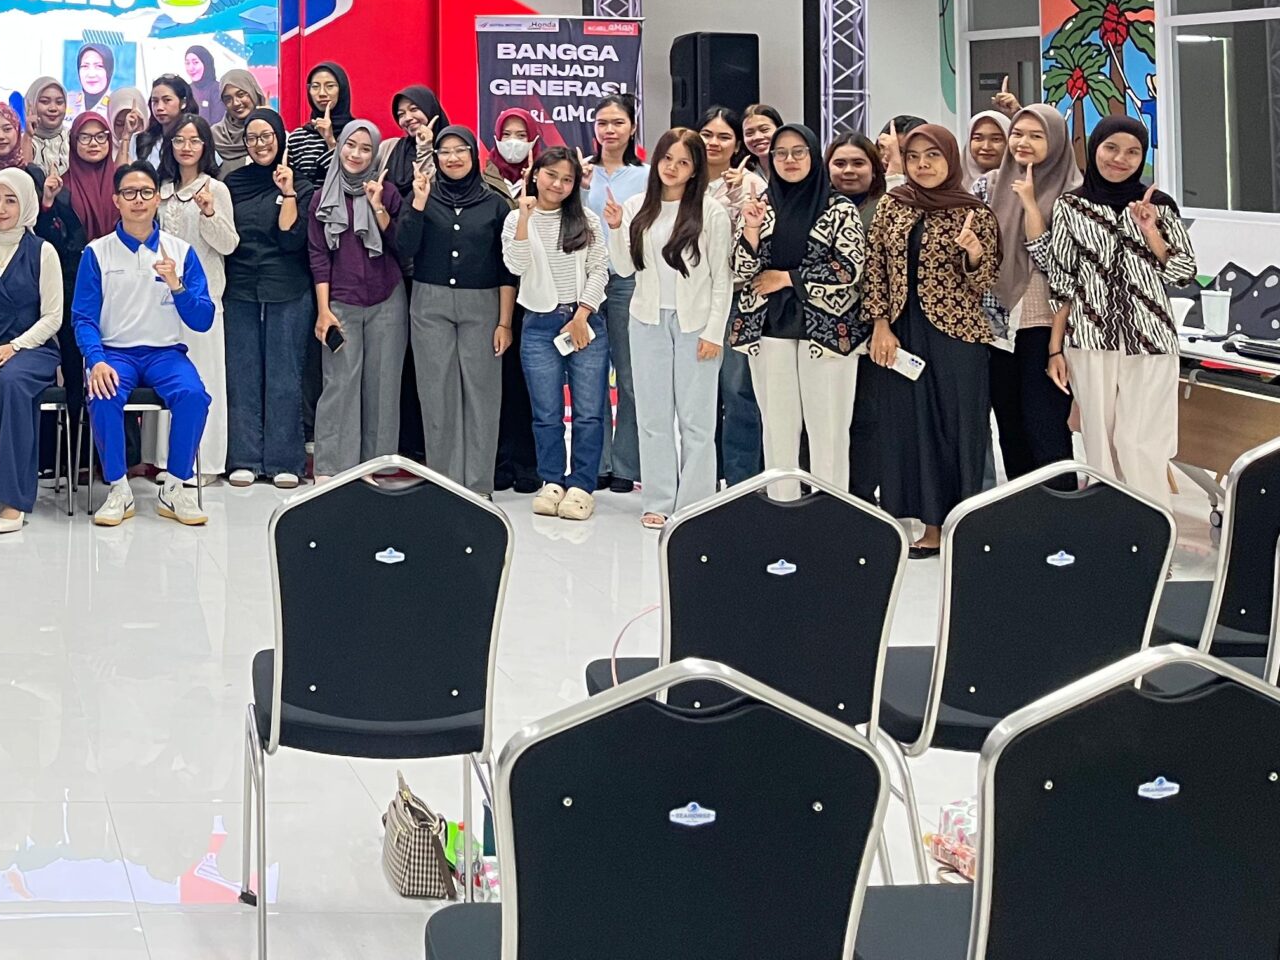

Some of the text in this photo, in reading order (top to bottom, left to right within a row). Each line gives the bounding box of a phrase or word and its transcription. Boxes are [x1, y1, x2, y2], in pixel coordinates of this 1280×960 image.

[497, 43, 620, 62] BANGGA
[511, 63, 604, 78] MENJADI
[489, 79, 627, 98] GENERASI
